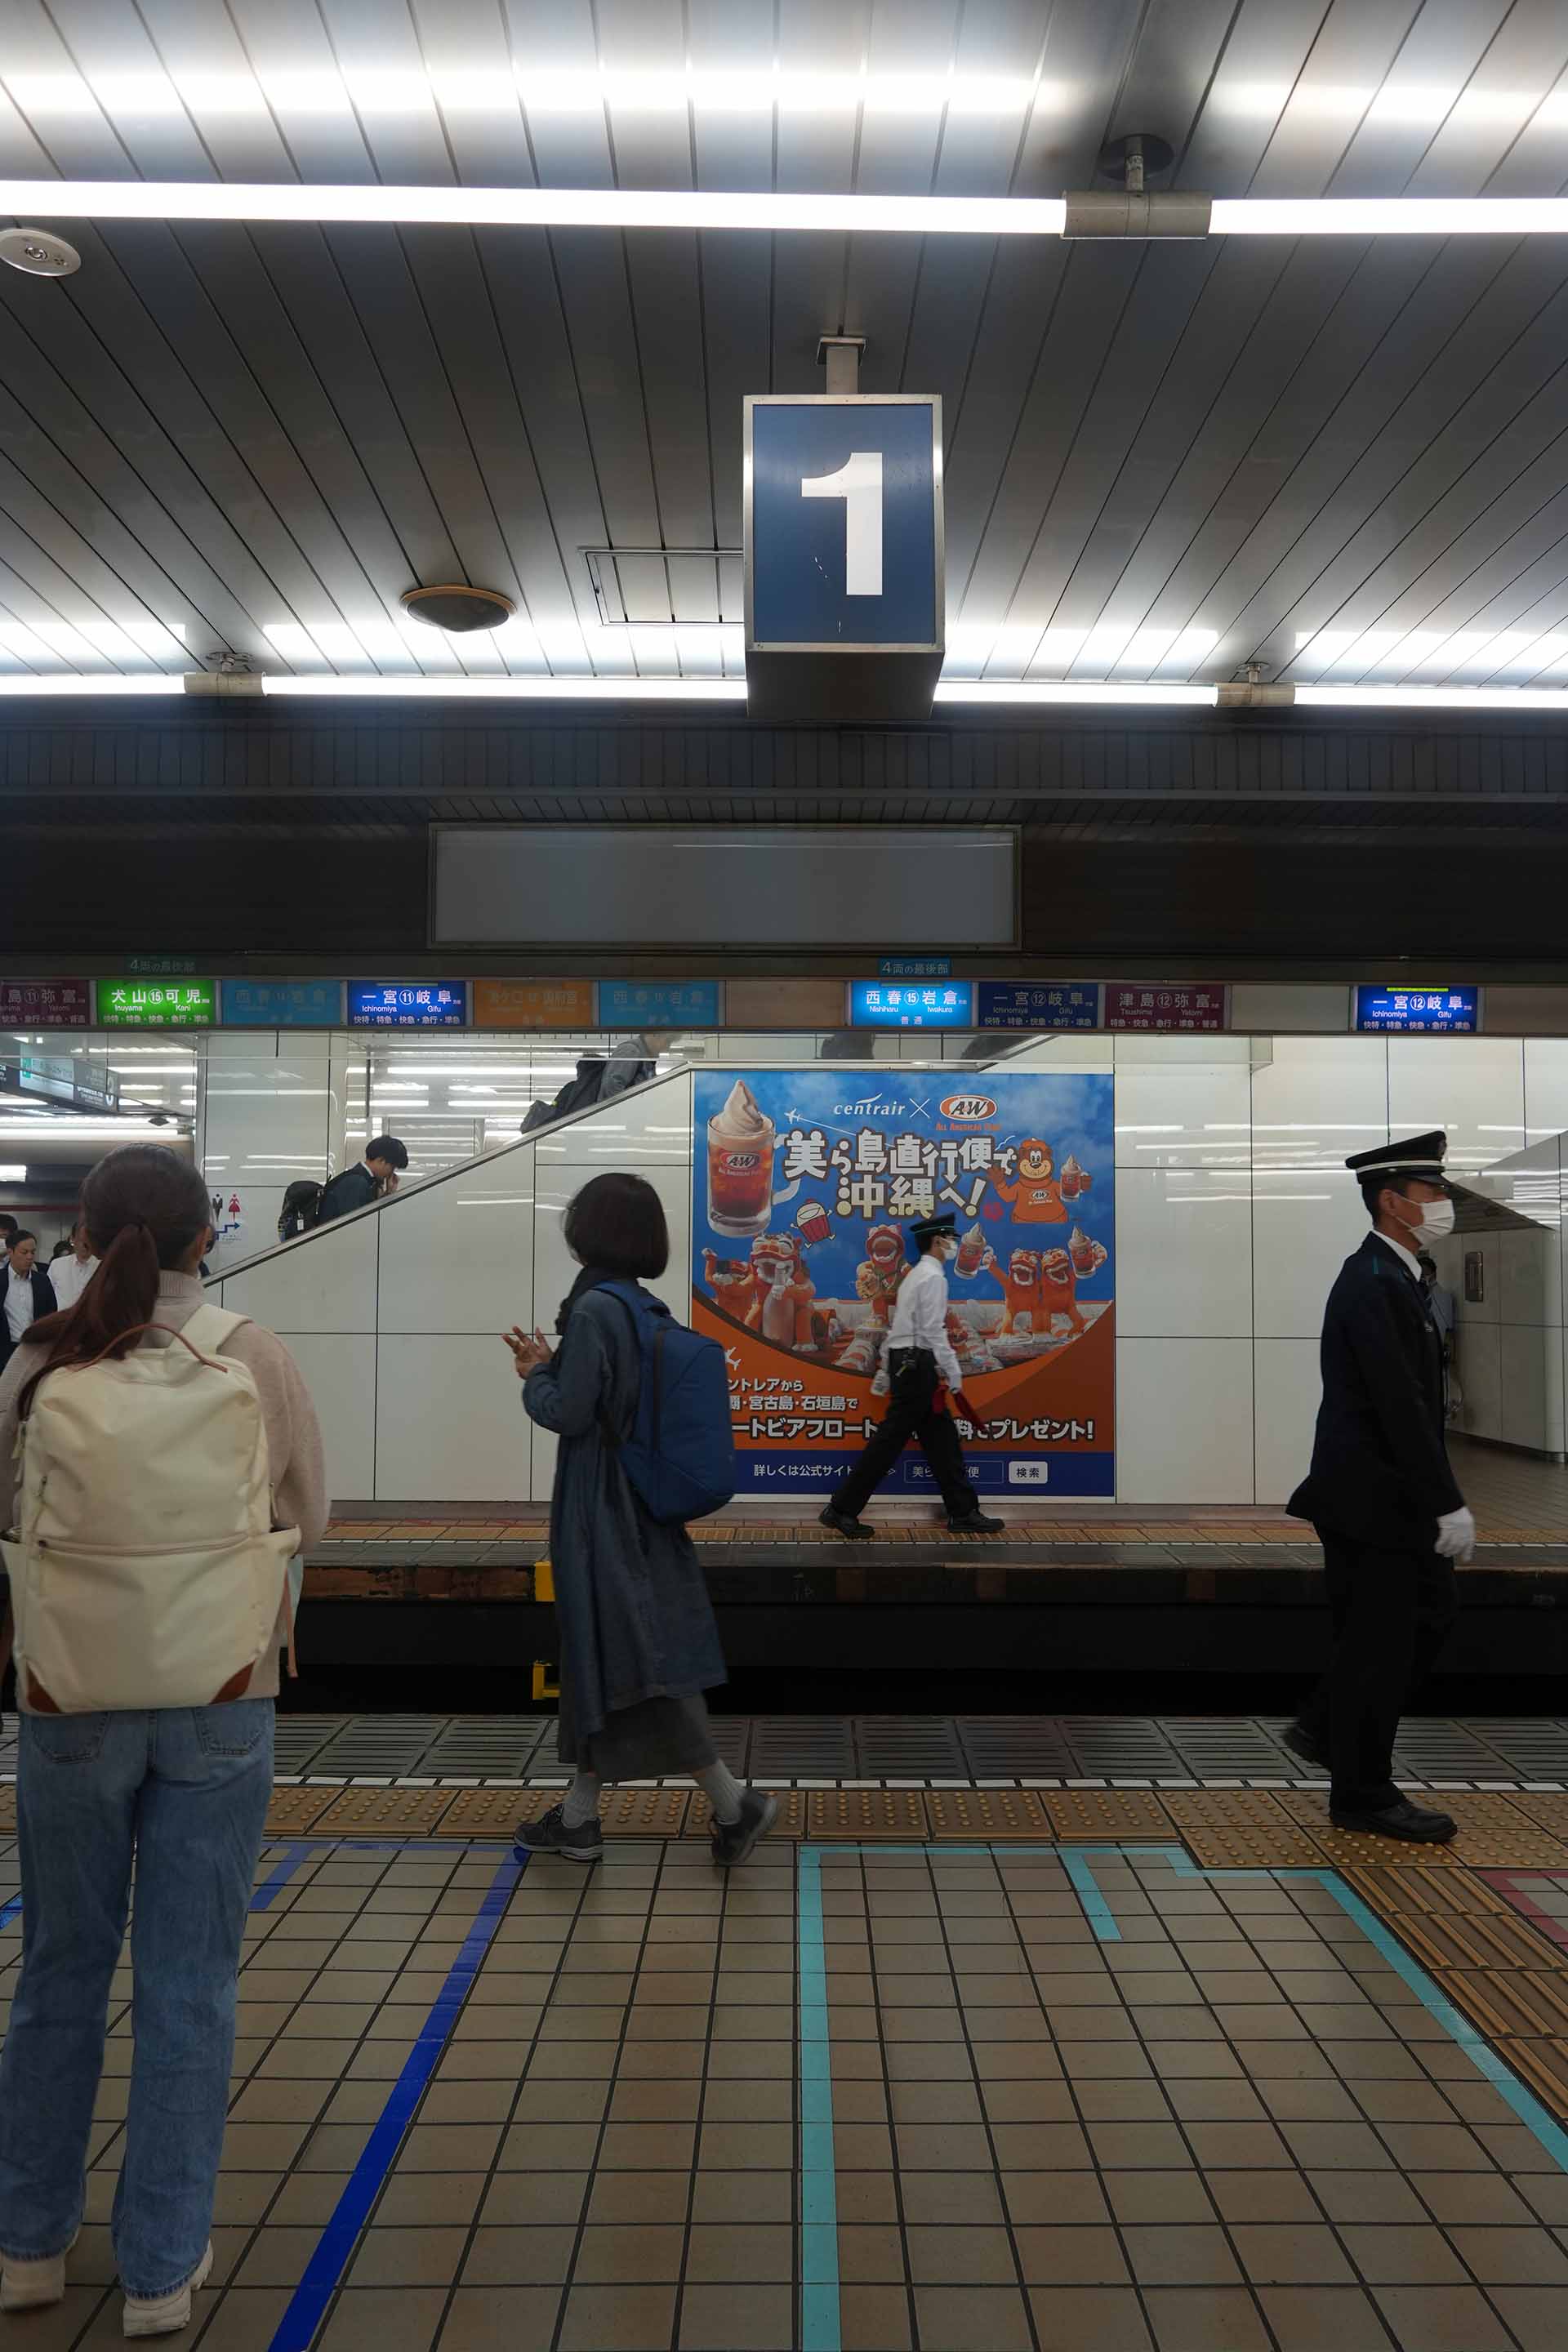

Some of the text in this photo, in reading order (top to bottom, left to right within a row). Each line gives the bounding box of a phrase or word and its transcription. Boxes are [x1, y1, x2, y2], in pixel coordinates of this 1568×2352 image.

[801, 452, 883, 595] 1
[882, 961, 948, 974] 4両の最後部
[114, 1004, 143, 1013] Inuyama
[362, 1005, 398, 1013] Ichinomiya
[1372, 1010, 1408, 1019] Ichinomiya
[833, 1095, 906, 1116] centrair
[785, 1129, 1017, 1181] 美ら島直行便で
[836, 1175, 987, 1218] 沖縄へ!
[1016, 1467, 1040, 1478] 検索
